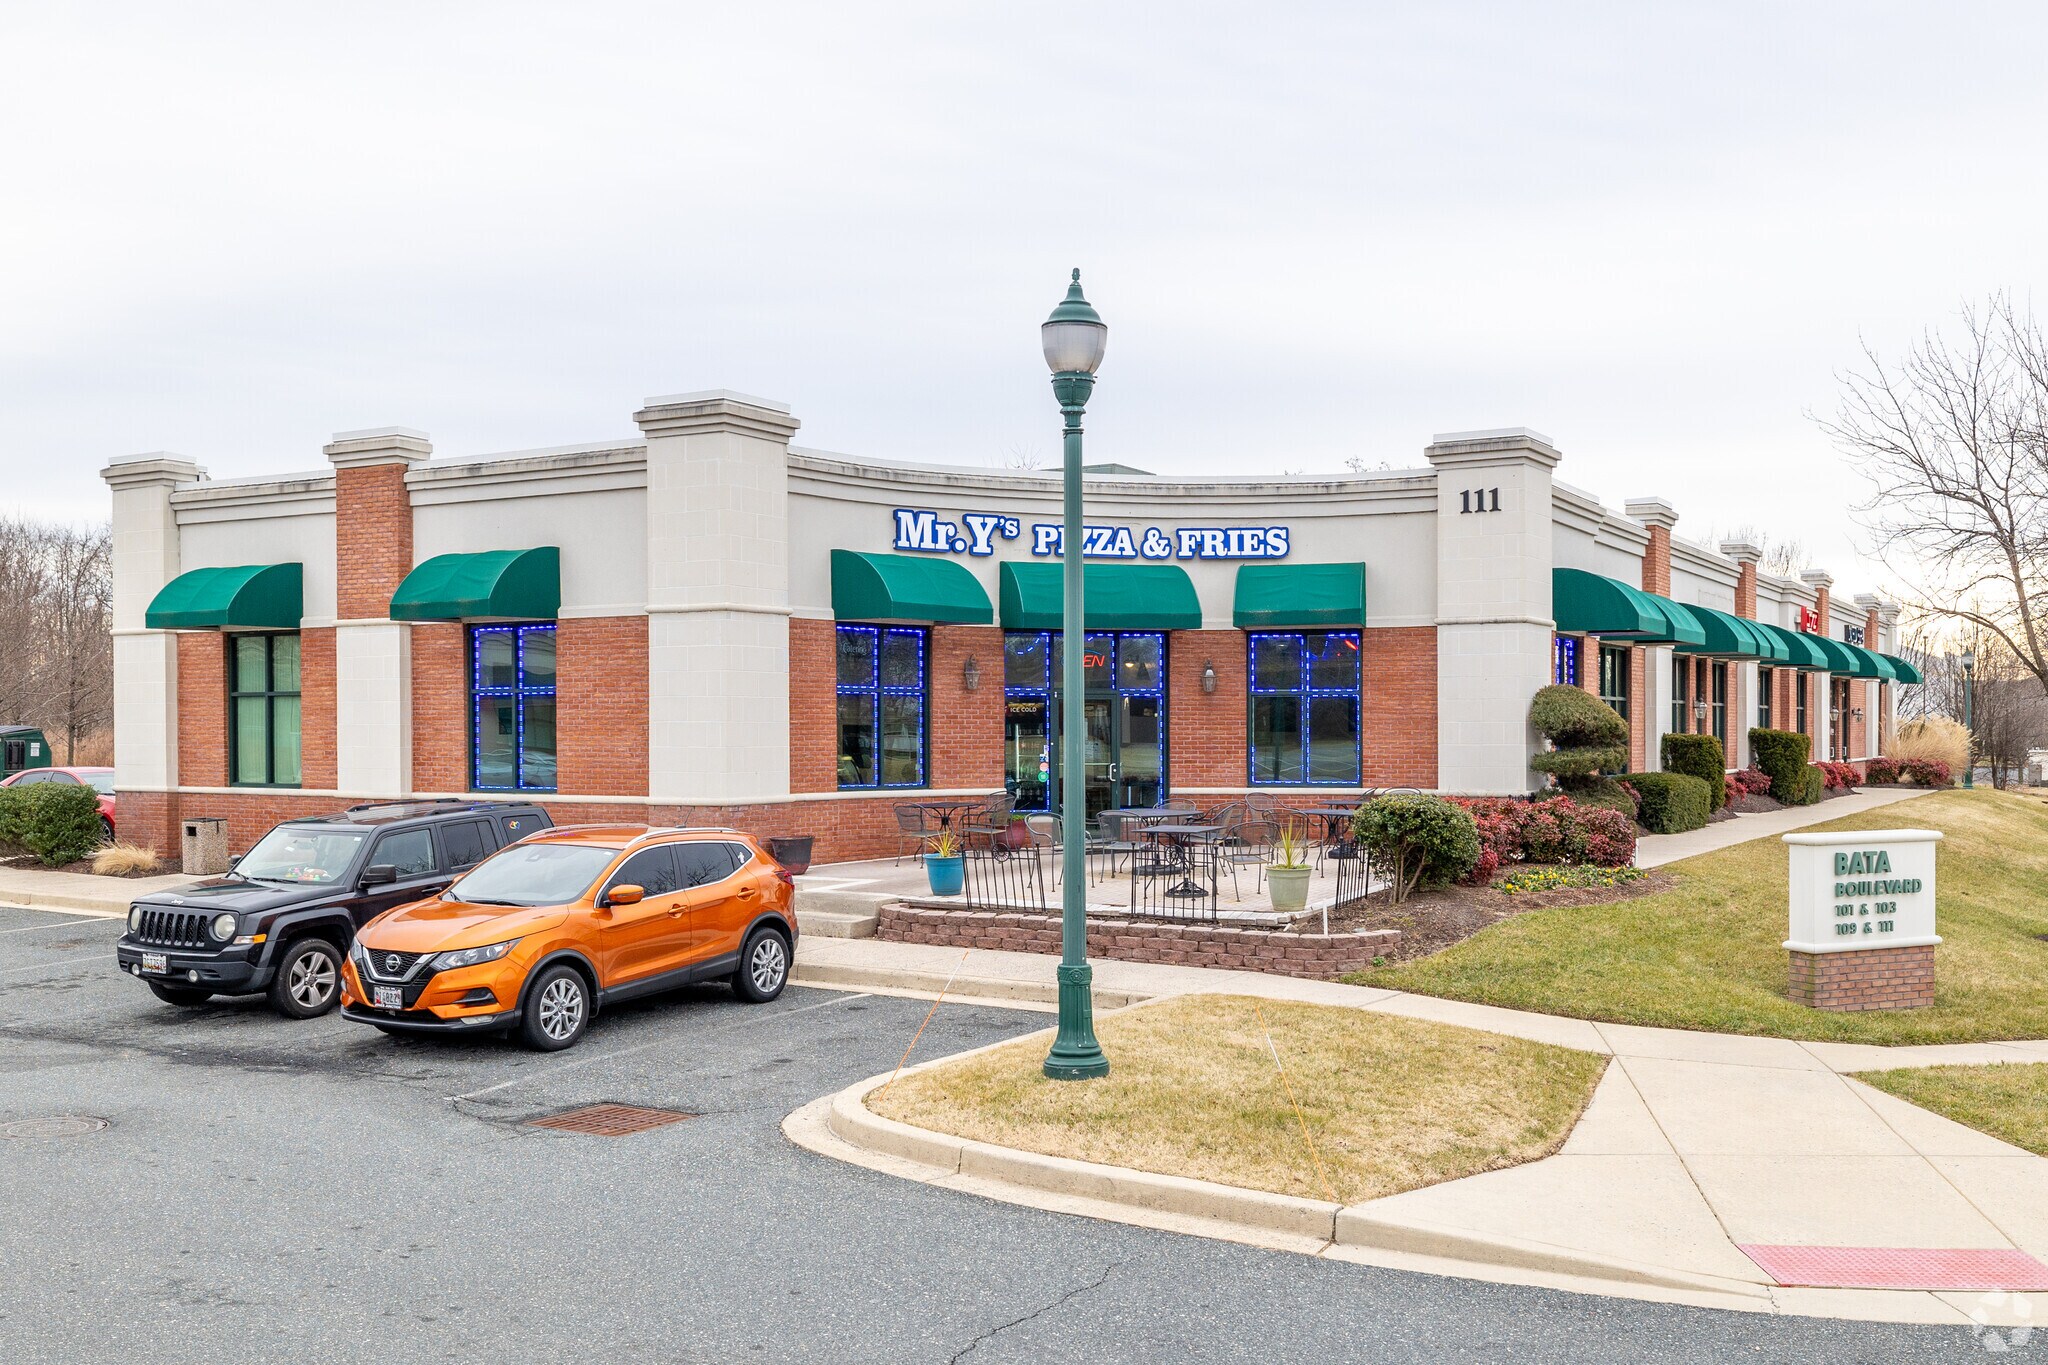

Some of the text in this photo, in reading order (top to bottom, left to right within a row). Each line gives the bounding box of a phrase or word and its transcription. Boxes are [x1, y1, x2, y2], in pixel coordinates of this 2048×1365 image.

[1459, 486, 1502, 515] 111
[893, 509, 1020, 556] Mr.Y's
[1141, 526, 1171, 560] &
[1176, 526, 1290, 560] FRIES
[1834, 850, 1892, 877] BATA
[1834, 878, 1923, 898] BOULEVARD
[1834, 901, 1897, 917] 101 & 103
[1835, 920, 1894, 936] 109 & 111
